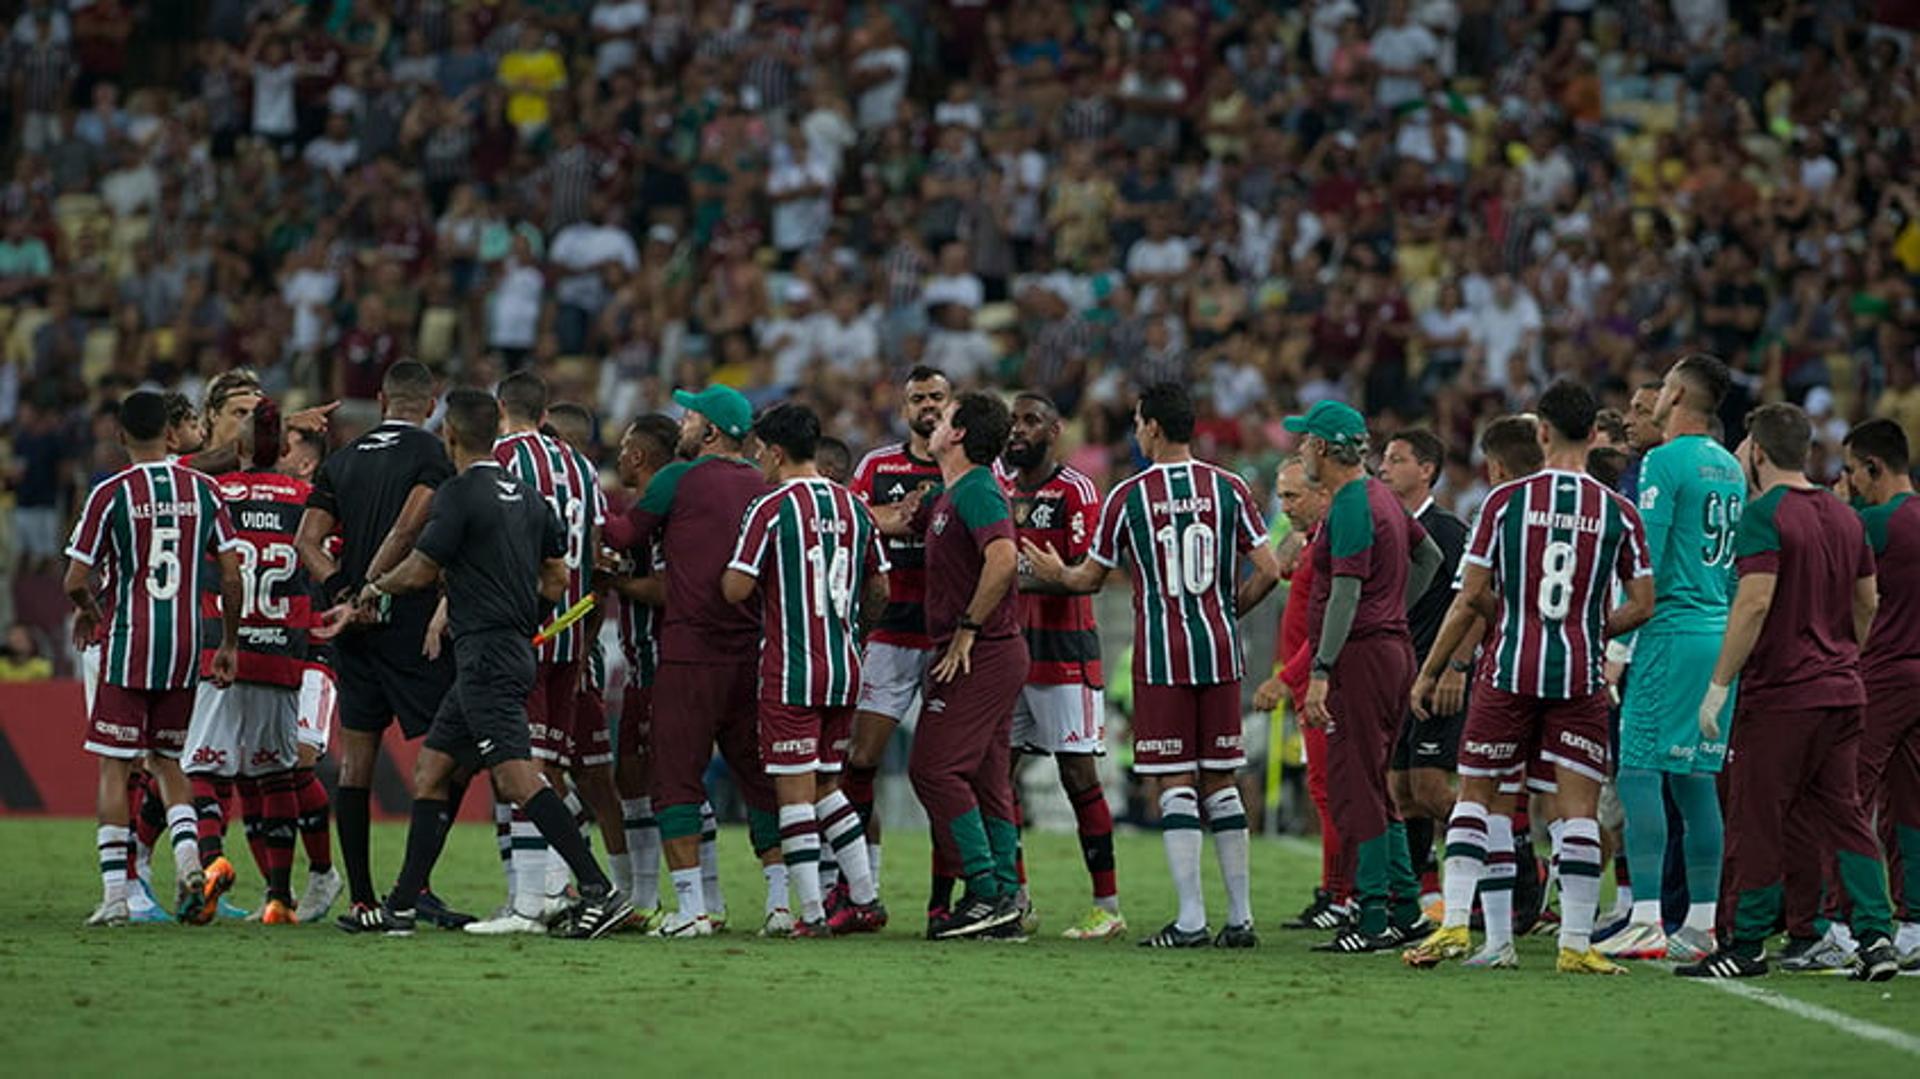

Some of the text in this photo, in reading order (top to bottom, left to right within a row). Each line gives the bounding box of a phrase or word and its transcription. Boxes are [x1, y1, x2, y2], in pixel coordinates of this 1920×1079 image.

[241, 510, 283, 531] VIDAL
[1526, 510, 1601, 533] MARTINELLI
[1701, 490, 1744, 570] 98
[144, 526, 181, 600] 5
[216, 538, 297, 619] 32
[807, 544, 849, 618] 14
[1156, 524, 1215, 597] 10
[1537, 541, 1577, 620] 8
[192, 745, 226, 765] abc
[252, 748, 281, 766] abc
